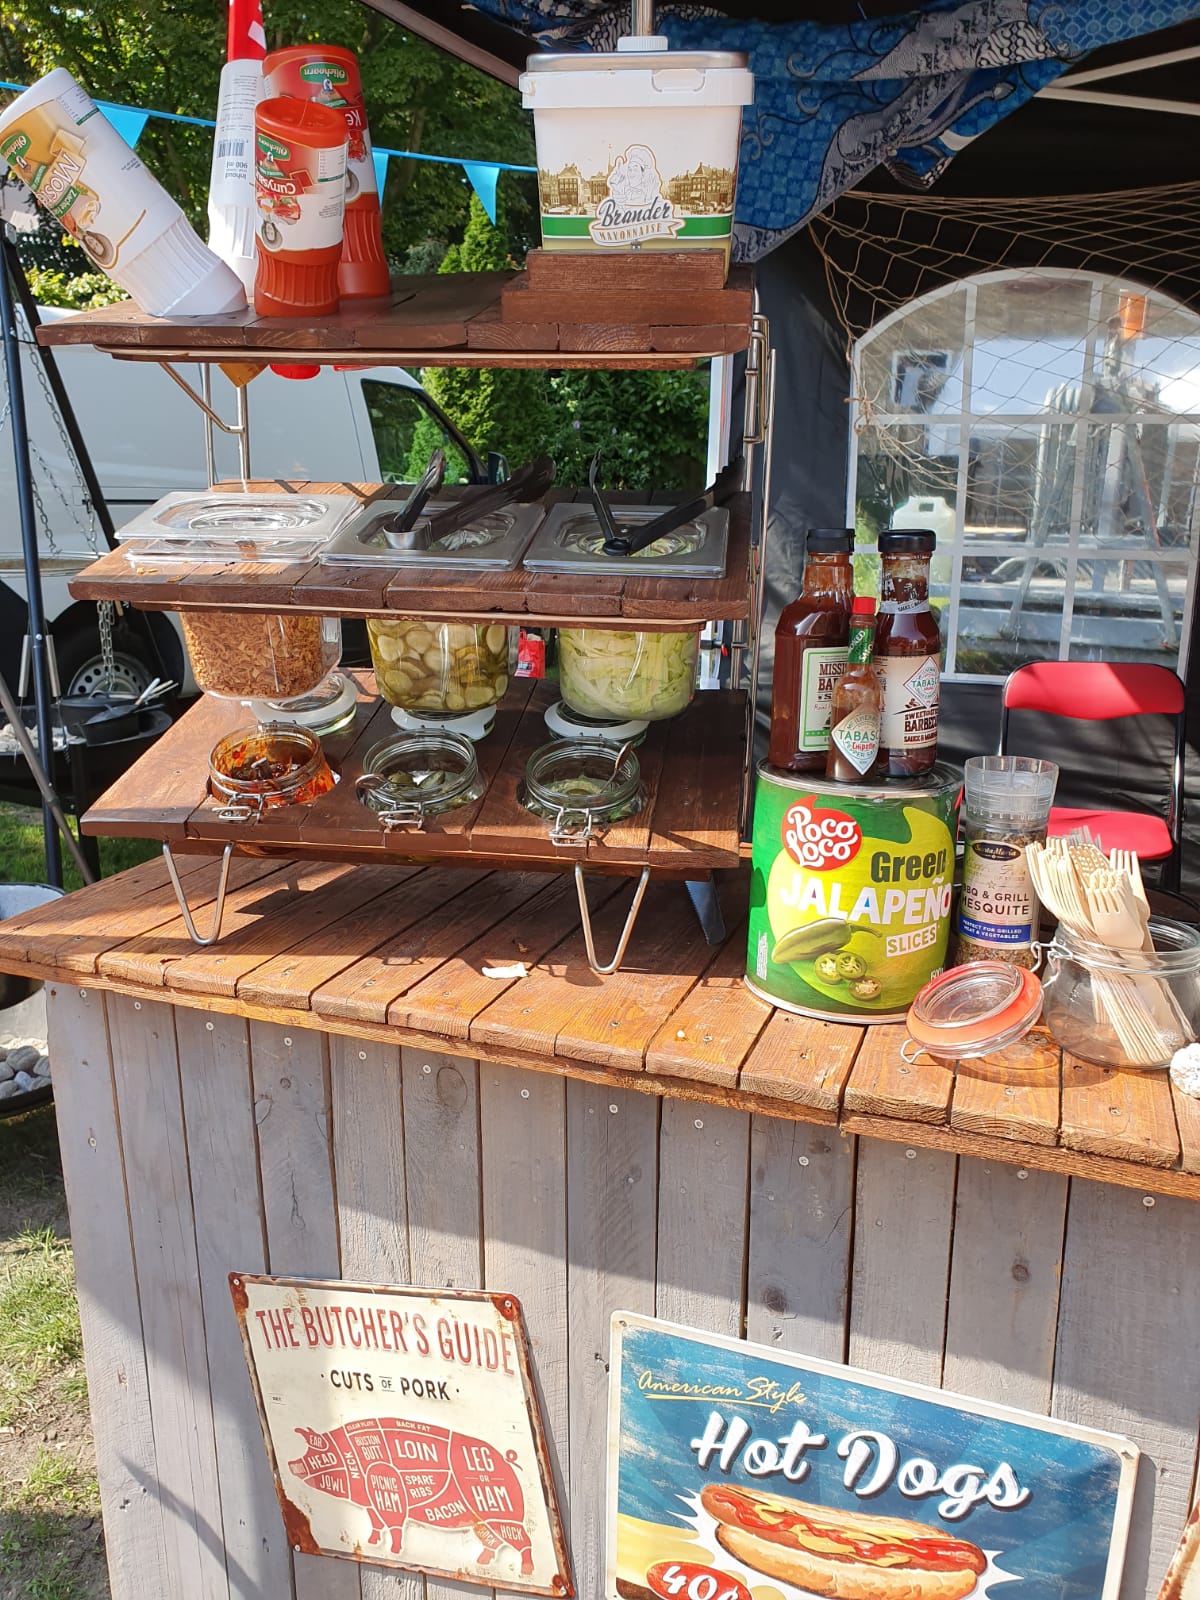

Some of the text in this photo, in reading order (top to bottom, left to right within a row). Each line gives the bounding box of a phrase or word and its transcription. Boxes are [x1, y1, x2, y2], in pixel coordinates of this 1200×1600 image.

[345, 110, 361, 126] Ke
[598, 196, 671, 227] Brander
[599, 223, 662, 240] MAYONNAISE
[871, 849, 947, 883] Green
[780, 872, 952, 925] JALAPEÑO
[982, 891, 990, 899] &
[995, 892, 1029, 901] GRILL
[888, 926, 936, 953] SLICES
[256, 1307, 515, 1376] THE BUTCHER'S GUIDE
[330, 1369, 450, 1400] CUTS OF PORK
[638, 1370, 808, 1414] American Style
[417, 1423, 431, 1432] FAT
[309, 1435, 322, 1447] EAR
[395, 1439, 438, 1462] LOIN
[308, 1452, 337, 1470] HEAD
[361, 1446, 383, 1461] BUTT
[462, 1446, 494, 1472] LEG
[344, 1451, 361, 1479] NECK
[690, 1410, 1033, 1523] Hot Dogs
[320, 1475, 346, 1494] JOWL
[370, 1474, 399, 1492] PICNIC
[405, 1475, 436, 1486] SPARE
[375, 1490, 402, 1513] HAM
[409, 1486, 433, 1498] RIBS
[471, 1486, 513, 1512] HAM
[424, 1500, 467, 1522] BACON
[500, 1525, 523, 1541] HOCK
